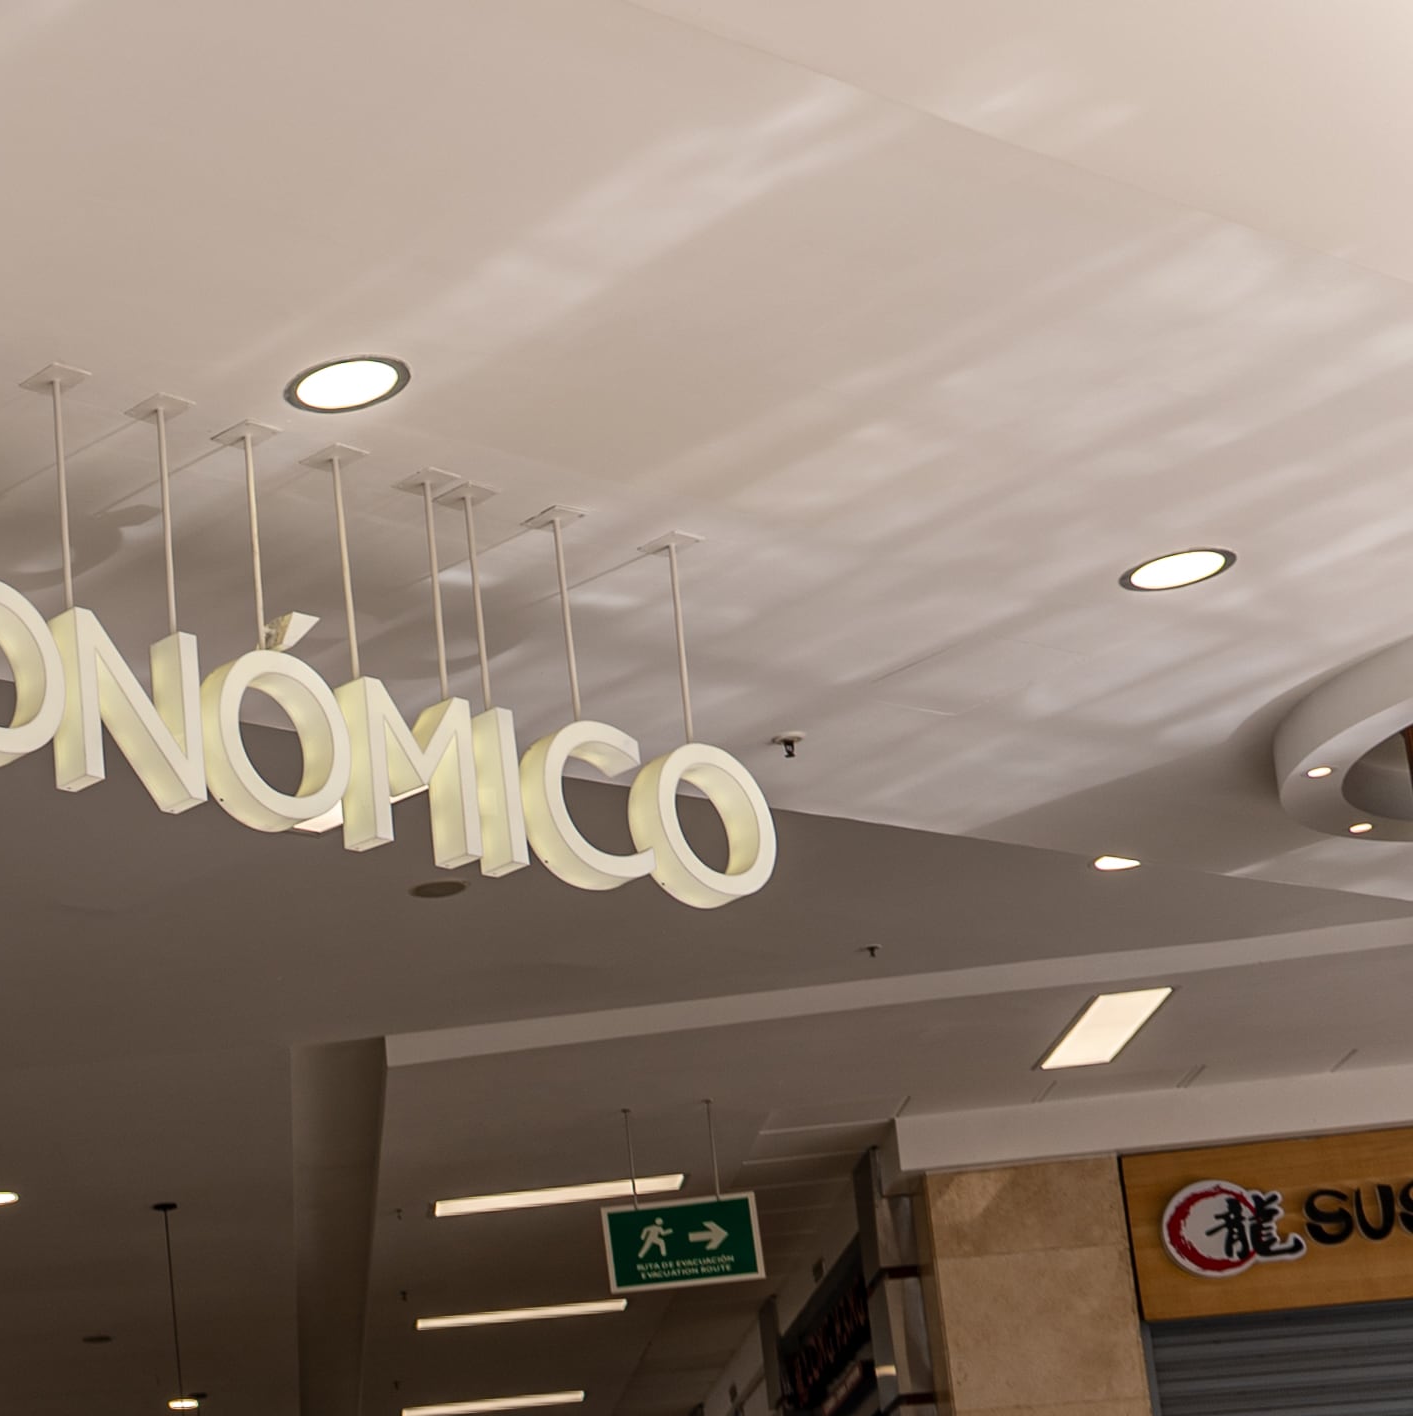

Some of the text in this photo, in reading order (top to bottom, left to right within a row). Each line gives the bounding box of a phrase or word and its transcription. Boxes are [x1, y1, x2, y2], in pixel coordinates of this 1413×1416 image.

[636, 1254, 735, 1271] RUTA DE EVACUACIÓN
[640, 1263, 732, 1280] EVACUATION ROUTE
